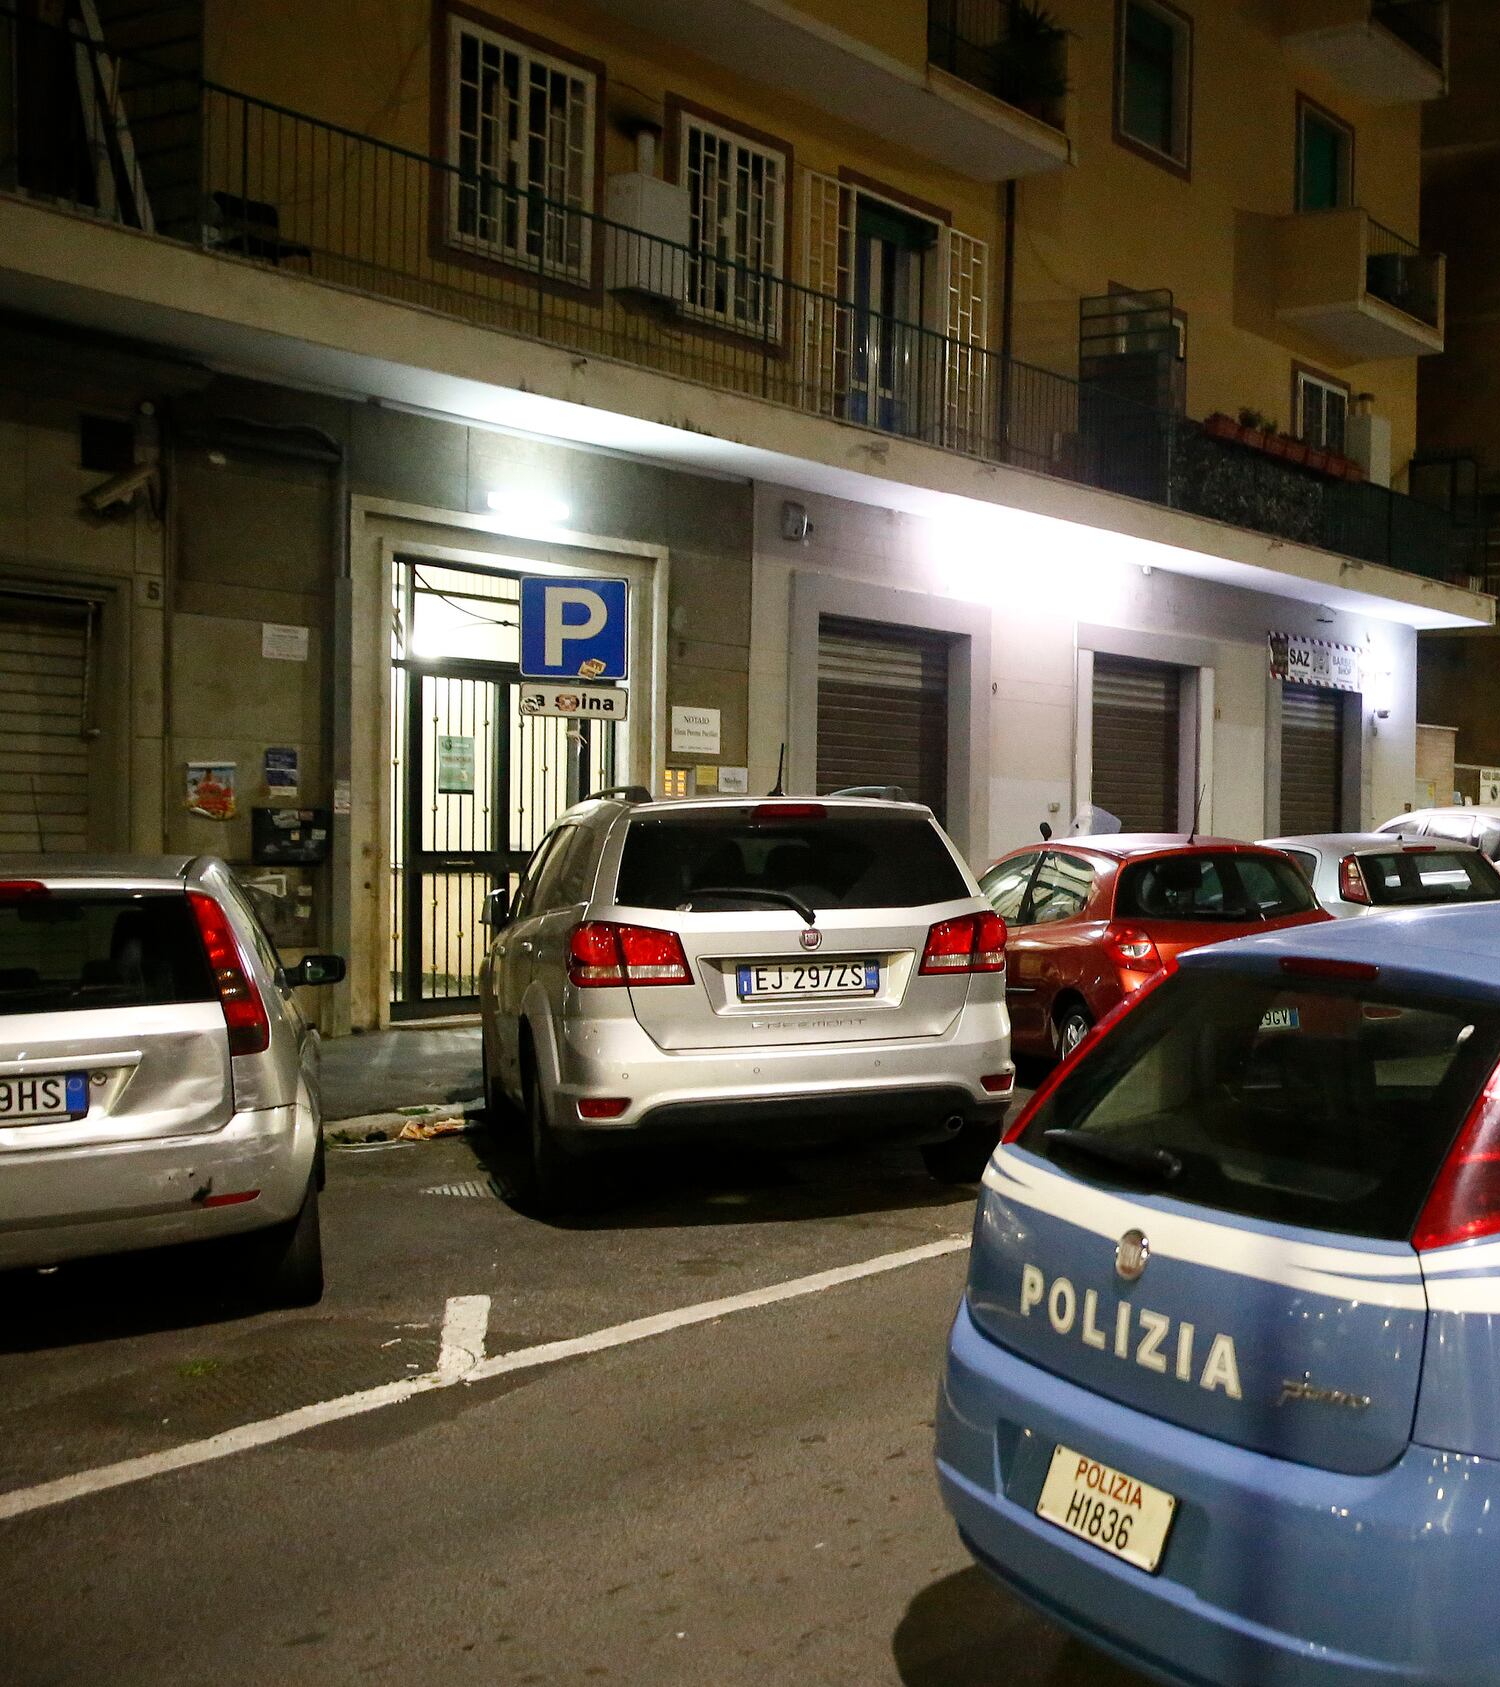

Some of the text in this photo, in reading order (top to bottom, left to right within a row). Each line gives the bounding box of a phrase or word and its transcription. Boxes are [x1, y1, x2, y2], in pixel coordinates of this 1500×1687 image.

[545, 586, 608, 666] P
[1290, 648, 1310, 668] SAZ
[755, 966, 783, 991] EJ
[793, 964, 864, 990] 297ZS
[0, 1080, 60, 1112] 9HS
[1020, 1263, 1243, 1400] POLIZIA
[1074, 1459, 1144, 1509] POLIZIA
